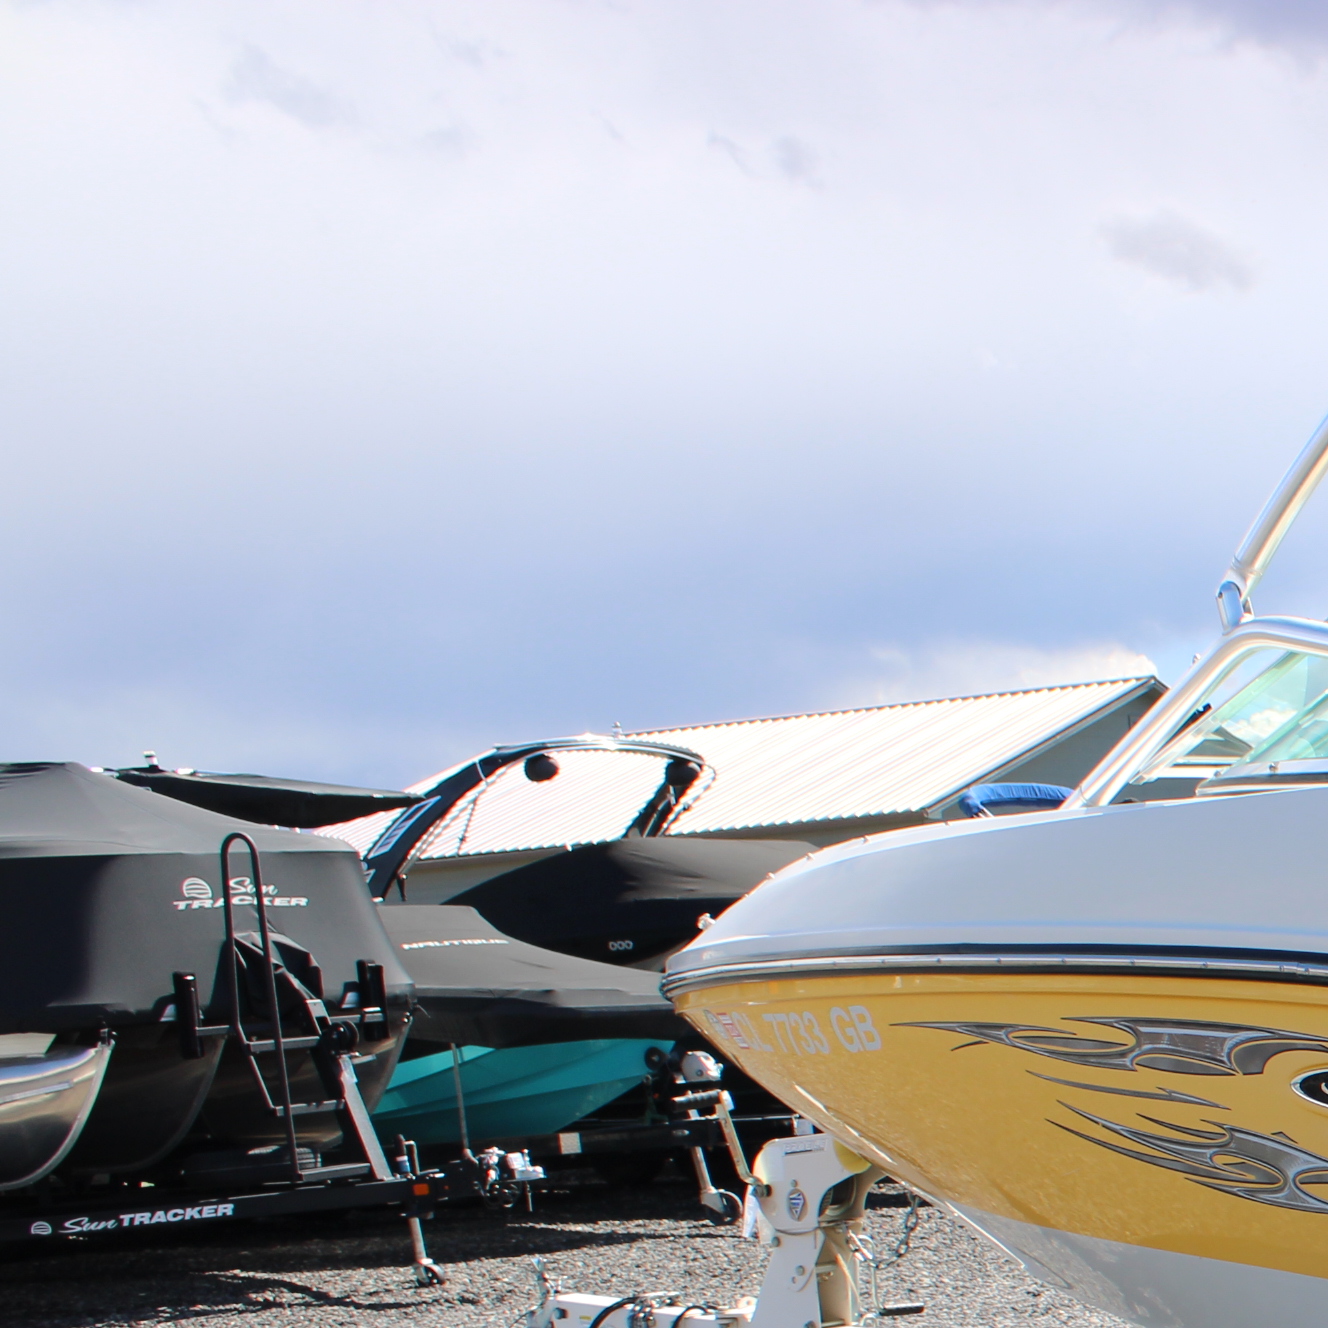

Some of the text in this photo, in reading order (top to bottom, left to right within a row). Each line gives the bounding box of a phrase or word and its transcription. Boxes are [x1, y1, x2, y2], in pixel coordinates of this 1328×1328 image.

[400, 938, 510, 951] NAUTIQUE
[829, 1005, 883, 1054] GB
[58, 1203, 235, 1234] Sun TRACKER
